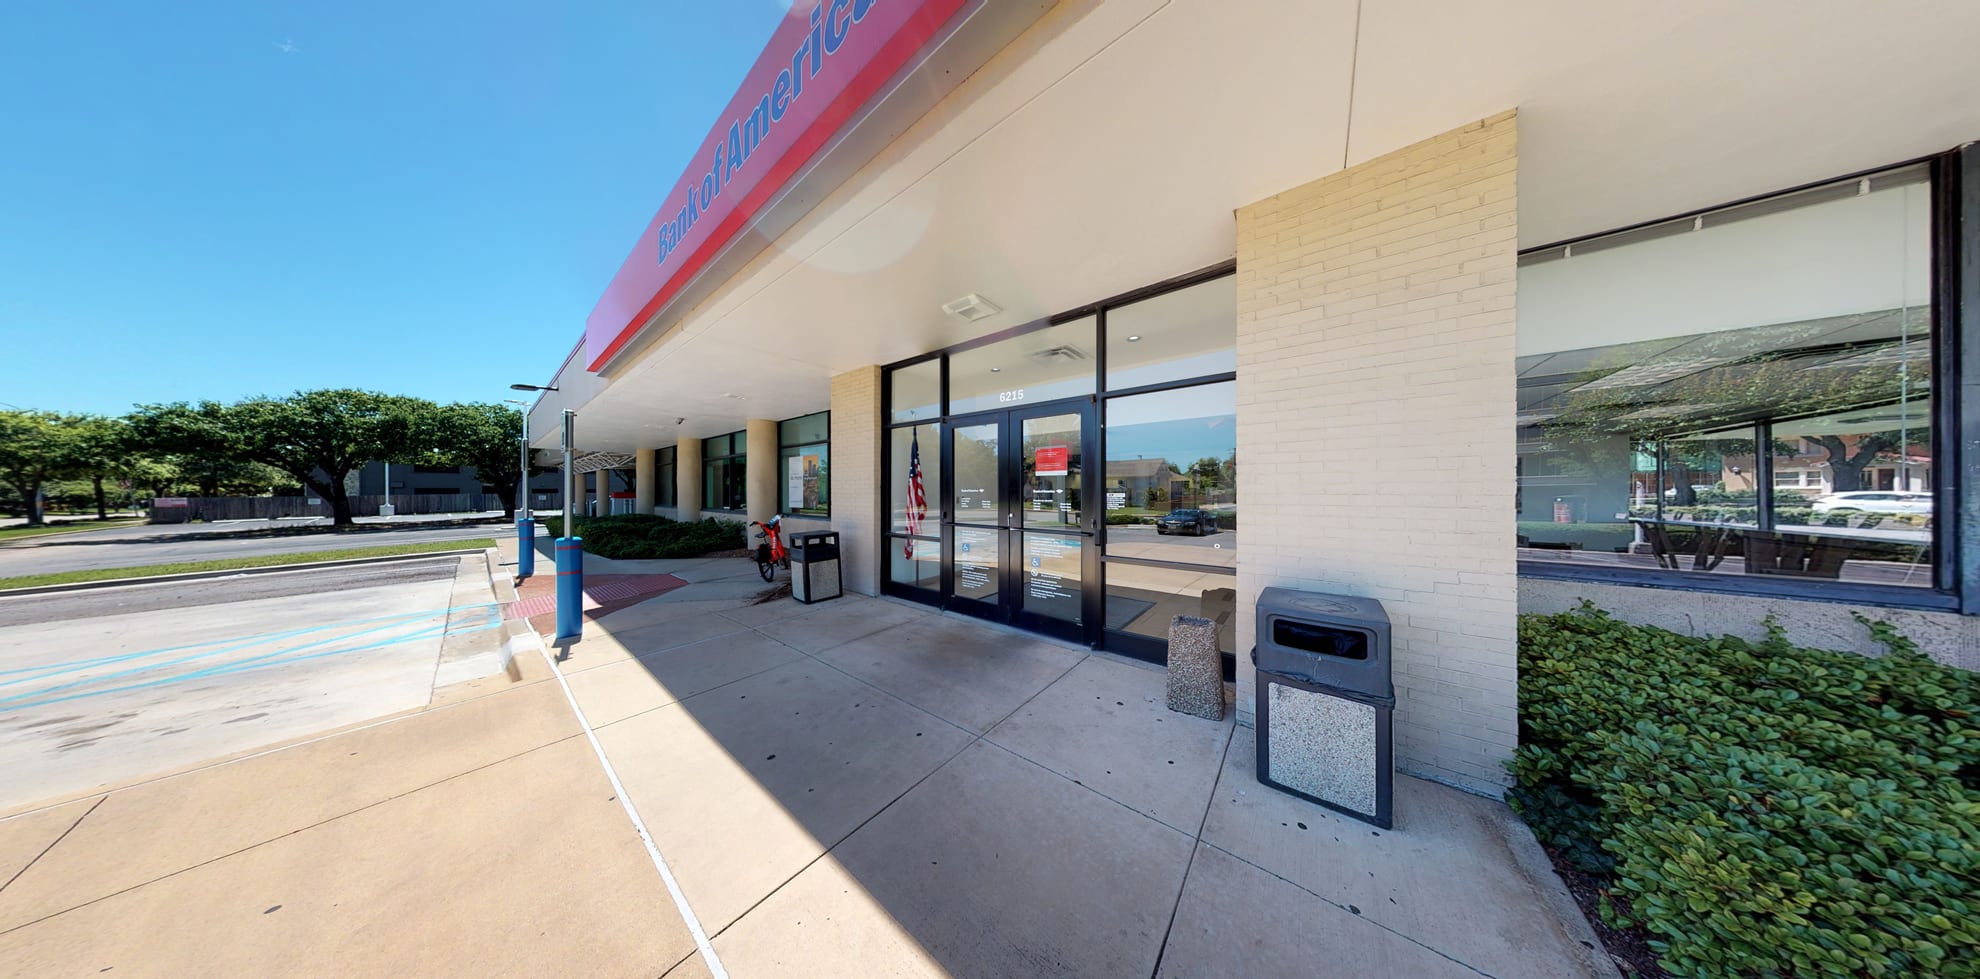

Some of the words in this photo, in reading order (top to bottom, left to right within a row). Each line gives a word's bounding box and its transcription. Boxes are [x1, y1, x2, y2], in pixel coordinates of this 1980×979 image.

[657, 183, 699, 266] Bank
[700, 140, 723, 212] of
[999, 389, 1024, 402] 6215
